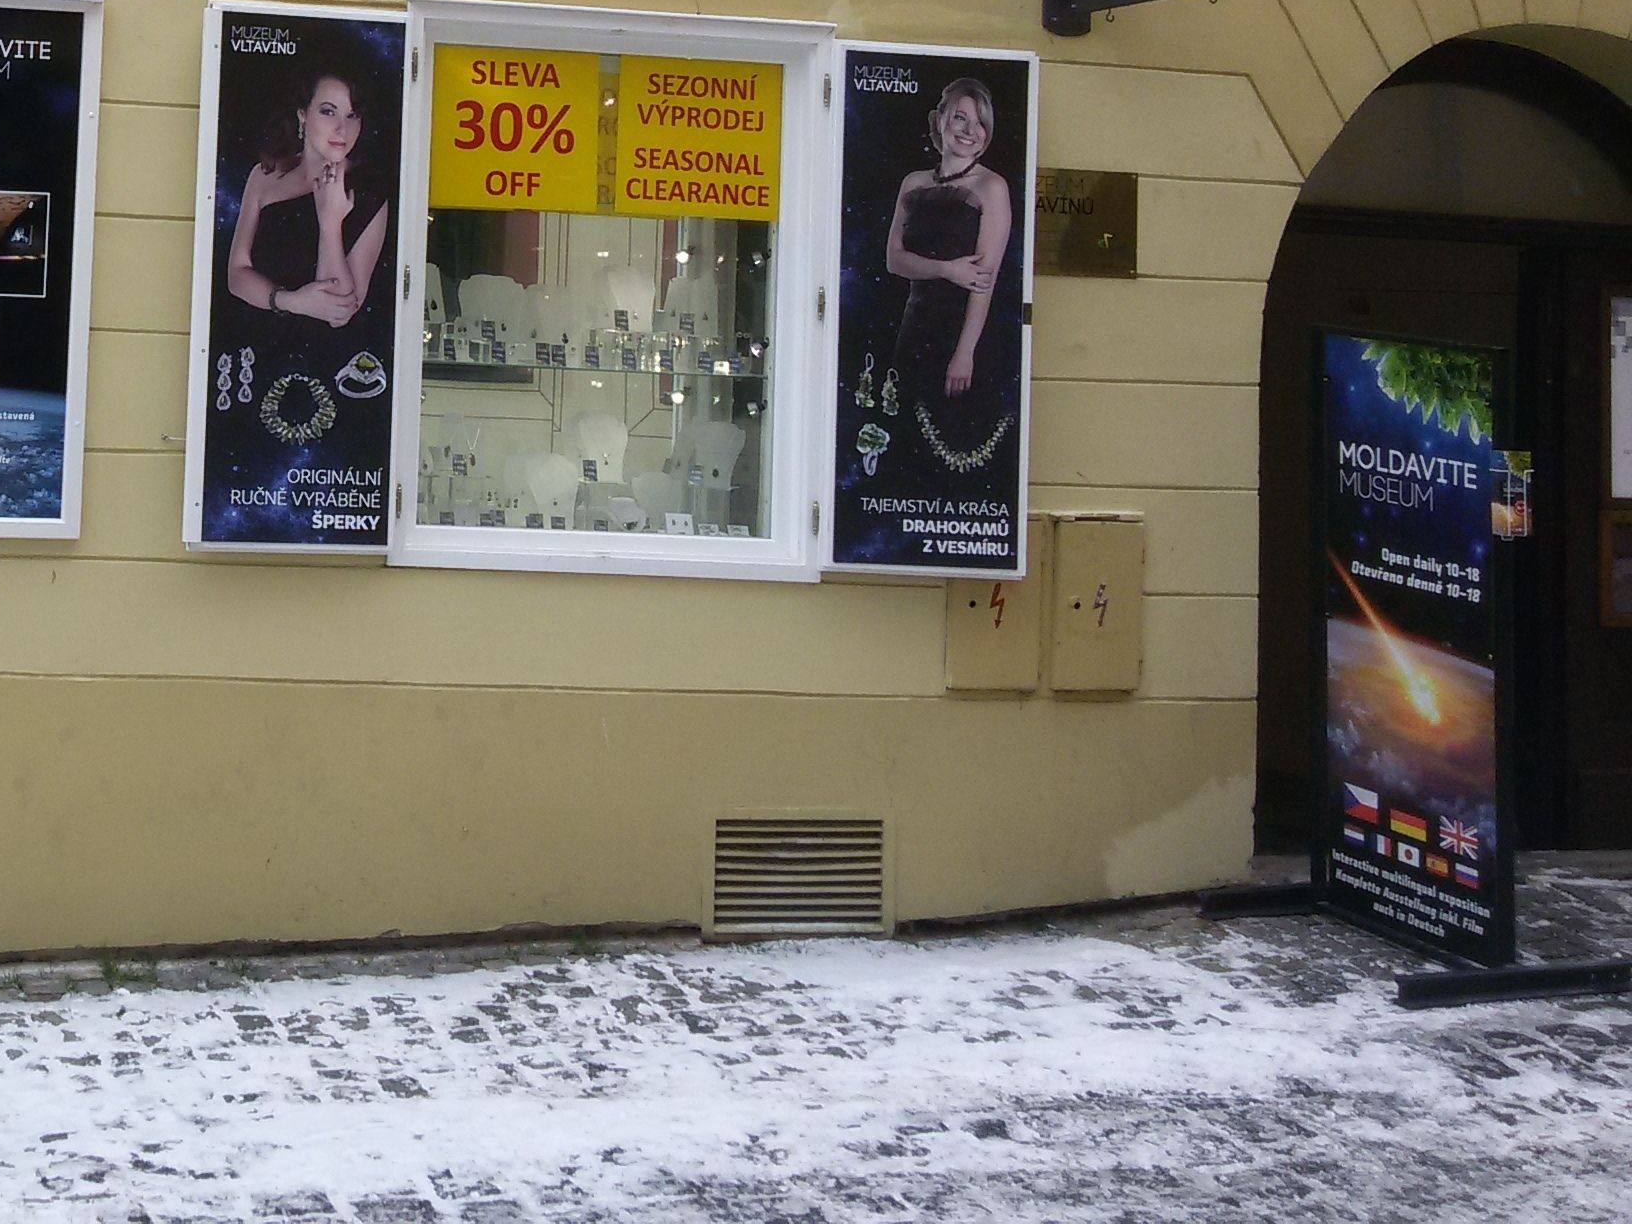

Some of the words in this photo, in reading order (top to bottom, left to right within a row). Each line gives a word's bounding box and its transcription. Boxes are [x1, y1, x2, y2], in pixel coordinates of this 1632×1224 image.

[231, 25, 289, 41] MUZEUM
[471, 59, 561, 89] SLEVA
[647, 73, 758, 101] SEZONNÍ
[854, 65, 912, 80] MUZEUM
[454, 99, 575, 155] 30%
[637, 99, 765, 133] VÝPRODEJ
[633, 147, 765, 177] SEASONAL
[485, 170, 541, 197] OFF
[625, 178, 770, 208] CLEARANCE
[1035, 194, 1094, 215] AVÍNŮ
[287, 466, 383, 487] ORIGINÁLNÍ
[1338, 440, 1478, 490] MOLDAVITE
[230, 486, 287, 507] RUČNĚ
[291, 489, 381, 509] VYRÁBĚNÉ
[1338, 469, 1434, 512] MUSEUM
[311, 510, 380, 531] ŠPERKY
[860, 496, 941, 514] TAJEMSTVÍ
[944, 500, 954, 515] A
[958, 499, 1009, 517] KRÁSA
[902, 518, 1009, 536] DRAHOKAMŮ
[922, 539, 933, 553] Z
[936, 538, 1009, 556] VESMÍRU
[1381, 547, 1410, 566] Open
[1413, 554, 1442, 577] daily
[1351, 560, 1404, 585] Otevřeno
[1406, 573, 1443, 594] denně
[1332, 848, 1380, 876] Interactive
[1381, 869, 1436, 898] multilingual
[1438, 891, 1491, 919] exposition
[1382, 886, 1437, 920] Ausstellung
[1462, 917, 1484, 936] Film
[1396, 908, 1406, 922] in
[1408, 913, 1445, 938] Deutsch
